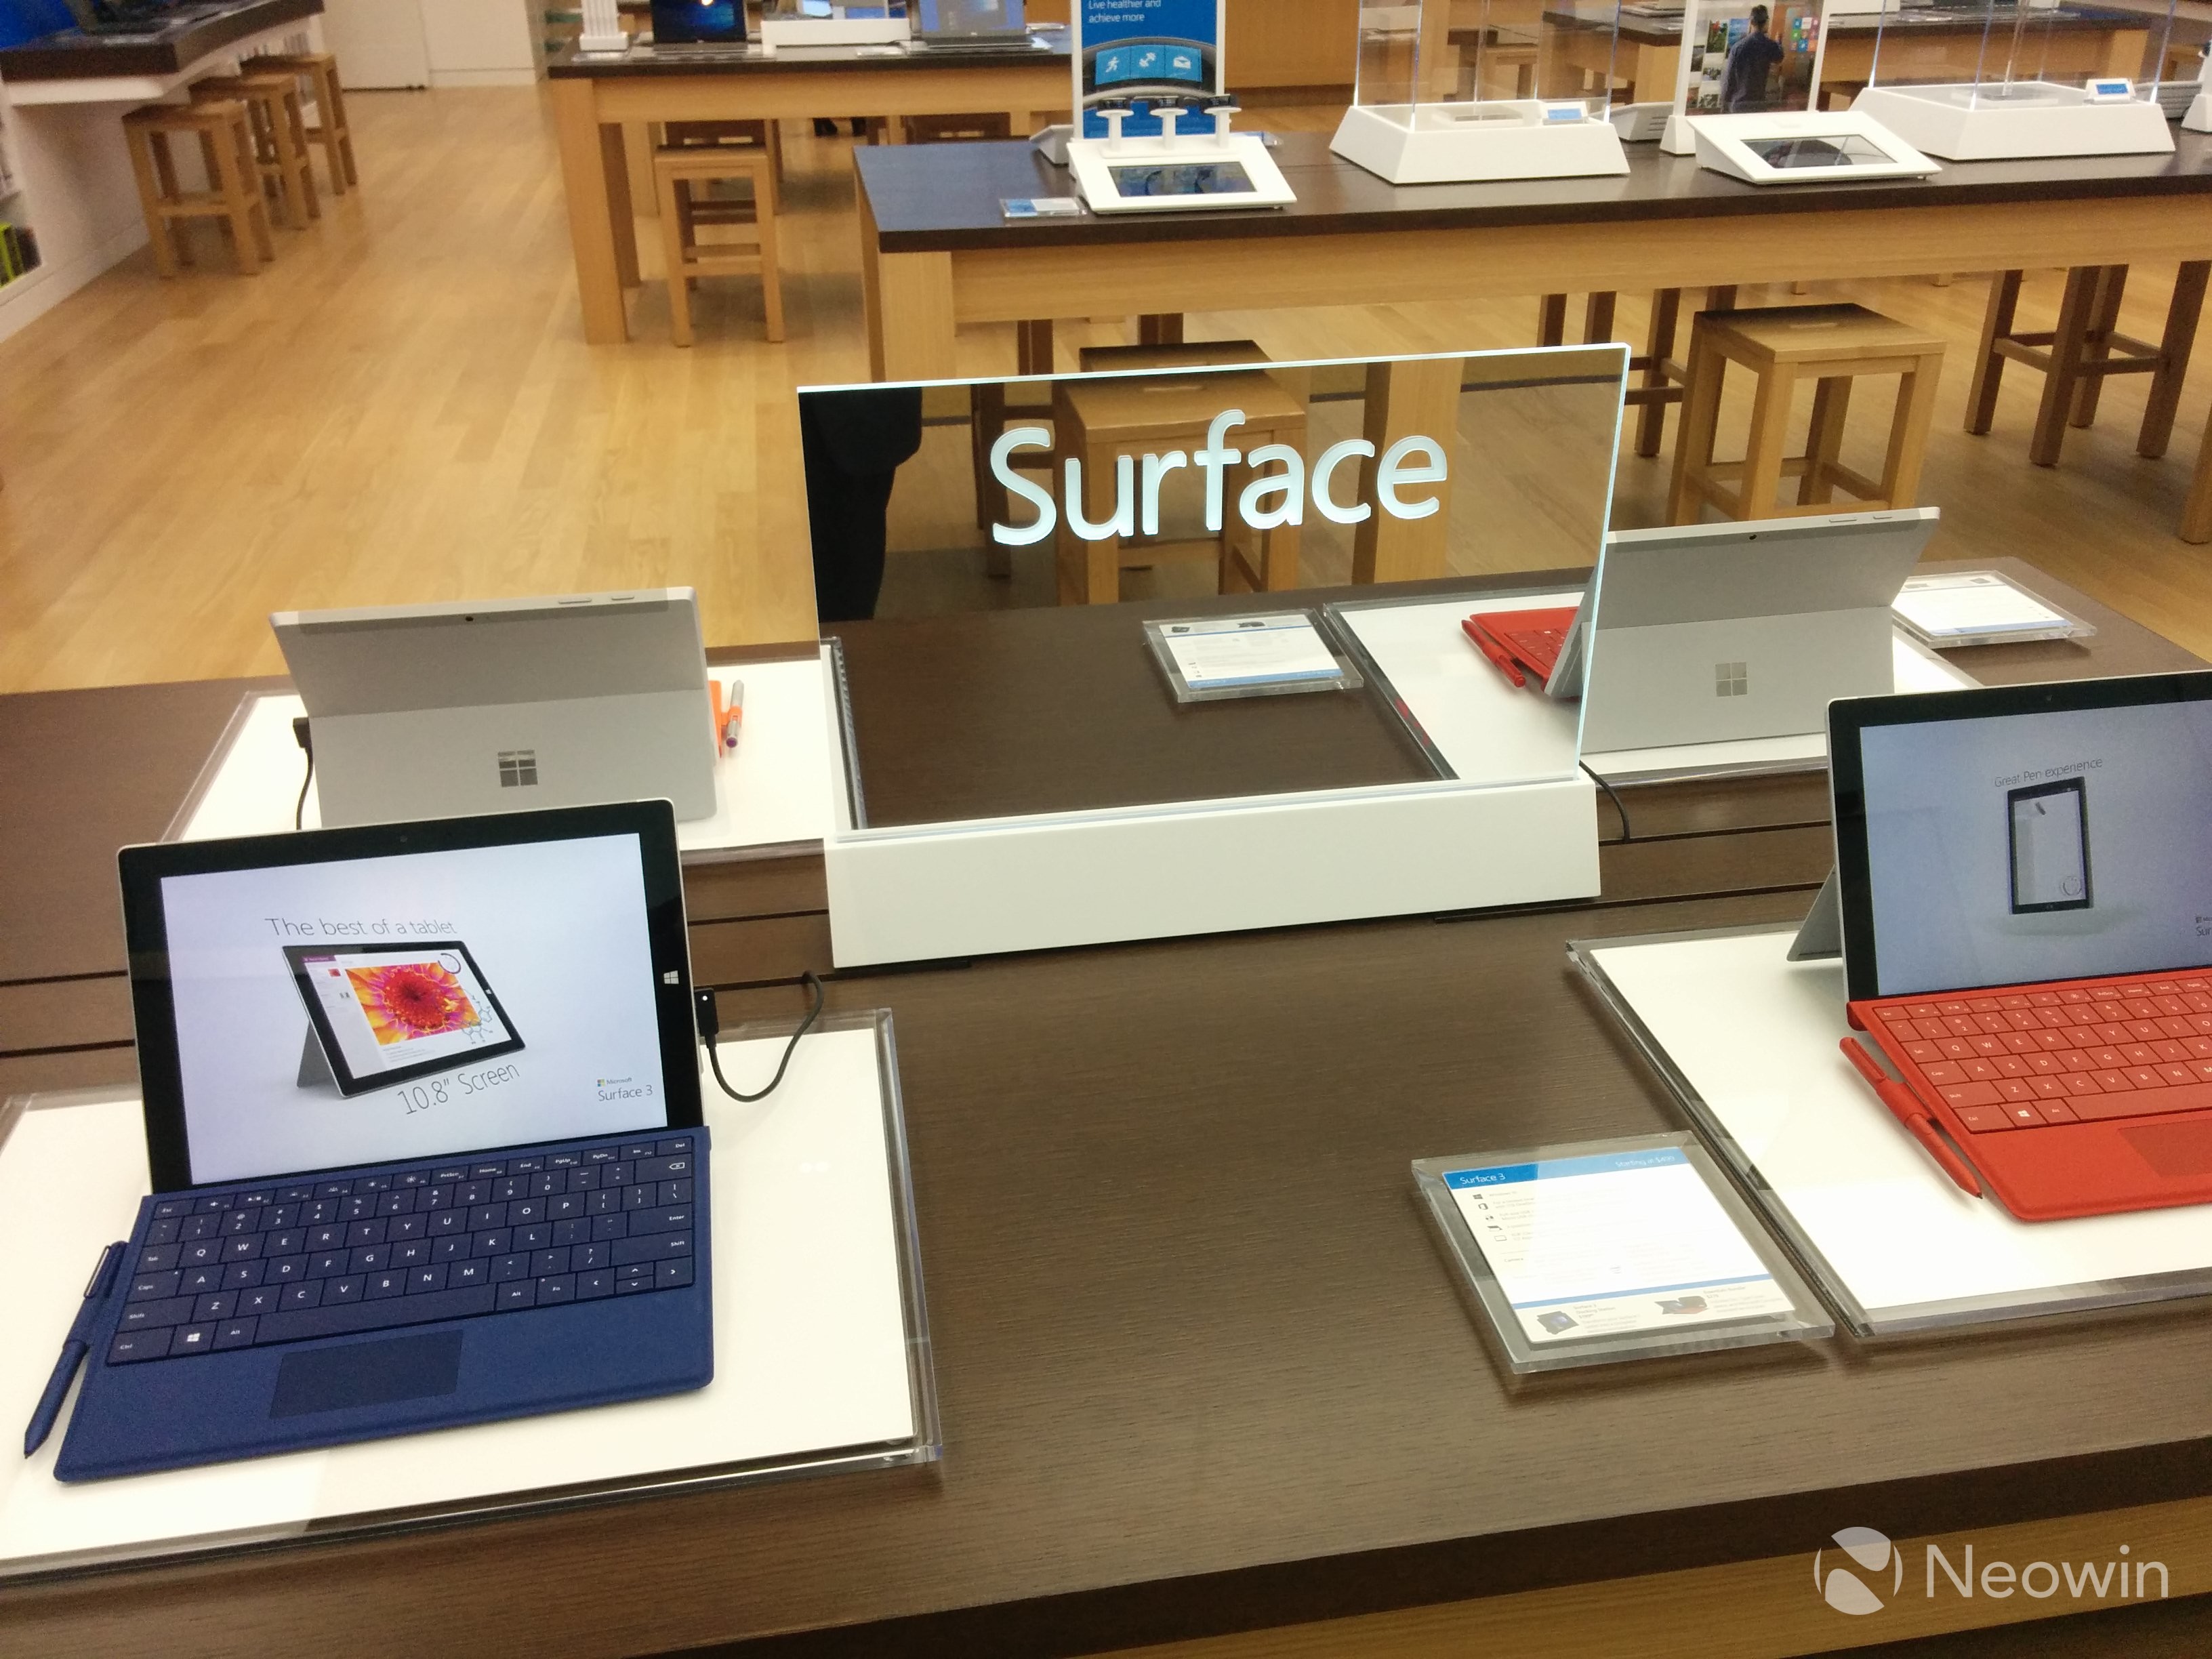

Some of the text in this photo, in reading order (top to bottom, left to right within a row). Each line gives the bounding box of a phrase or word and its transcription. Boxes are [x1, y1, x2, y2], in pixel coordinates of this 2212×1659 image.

[1088, 0, 1161, 9] Live healthier and
[1088, 14, 1145, 23] achieve more
[989, 409, 1448, 546] Surface
[1994, 758, 2103, 787] Great Pen experience
[264, 918, 457, 936] The best of a tablet
[397, 1064, 520, 1115] 10.8" Screen
[598, 1084, 653, 1101] Surface 3
[1460, 1174, 1497, 1185] Surface
[197, 1249, 206, 1257] Q
[211, 1302, 220, 1310] Z
